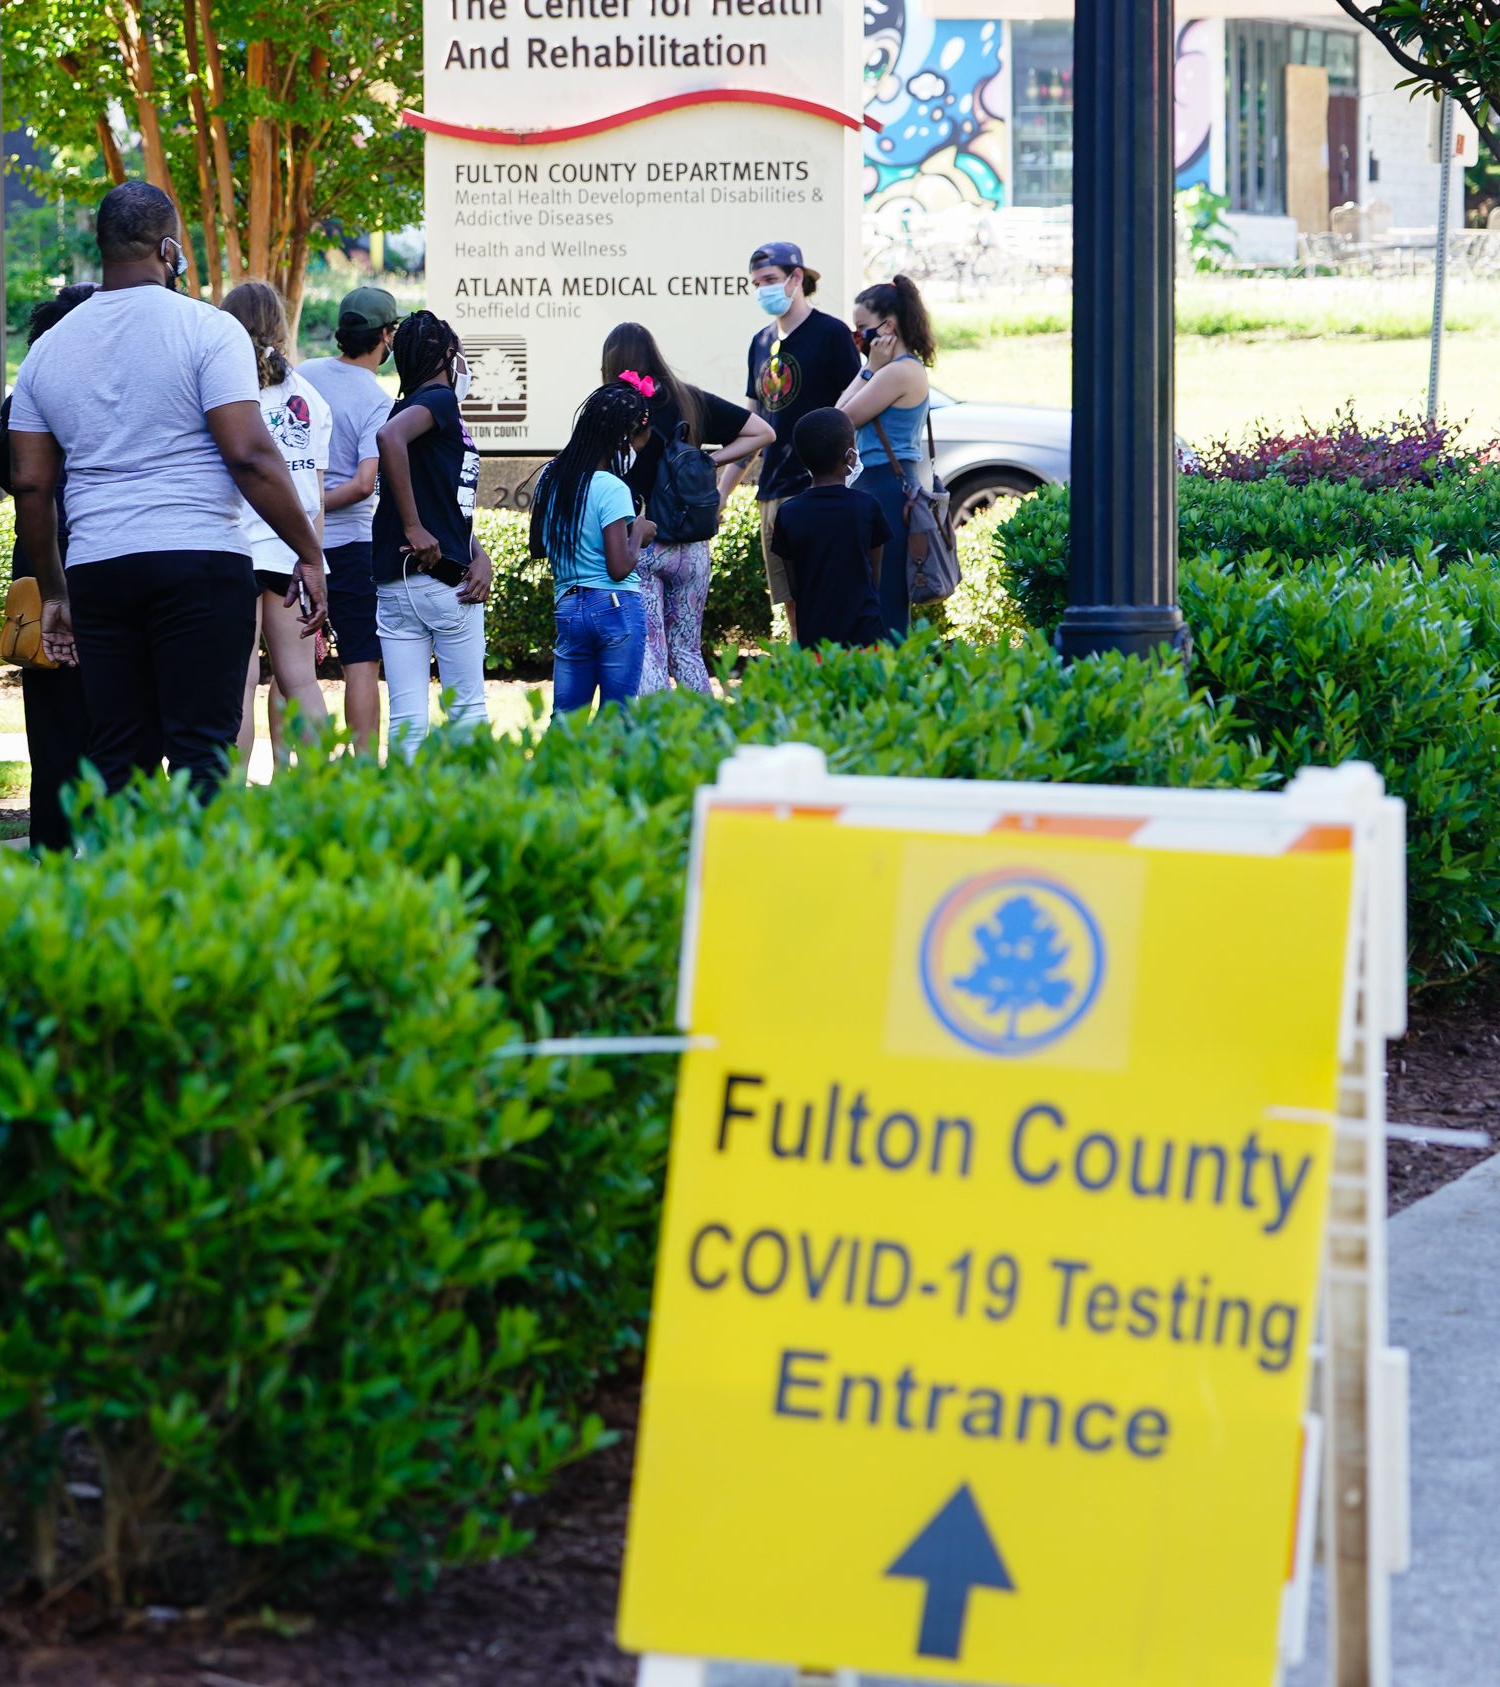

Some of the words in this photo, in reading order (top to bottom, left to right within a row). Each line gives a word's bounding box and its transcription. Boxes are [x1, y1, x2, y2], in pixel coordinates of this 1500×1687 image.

[524, 0, 631, 19] Center
[445, 38, 510, 70] And
[527, 34, 767, 69] Rehabilitation
[455, 164, 538, 184] FULTON
[548, 163, 637, 183] COUNTY
[647, 161, 809, 182] DEPARTMENTS
[455, 189, 512, 205] Mental
[518, 189, 572, 205] Health
[578, 187, 705, 207] Developmental
[711, 186, 806, 204] Disabilities
[812, 187, 824, 203] &
[455, 210, 533, 226] Addictive
[538, 210, 614, 226] Diseases
[455, 241, 509, 257] Health
[514, 241, 546, 257] and
[551, 240, 628, 257] Wellness
[455, 277, 552, 297] ATLANTA
[562, 276, 658, 296] MEDICAL
[667, 276, 750, 296] CENTER
[456, 302, 530, 319] Sheffield
[535, 302, 582, 319] Clinic
[494, 425, 529, 438] COUNTY
[715, 1072, 975, 1179] Fulton
[1009, 1103, 1313, 1234] County
[687, 1222, 1021, 1323] COVID-19
[1049, 1257, 1301, 1374] Testing
[771, 1346, 1171, 1460] Entrance
